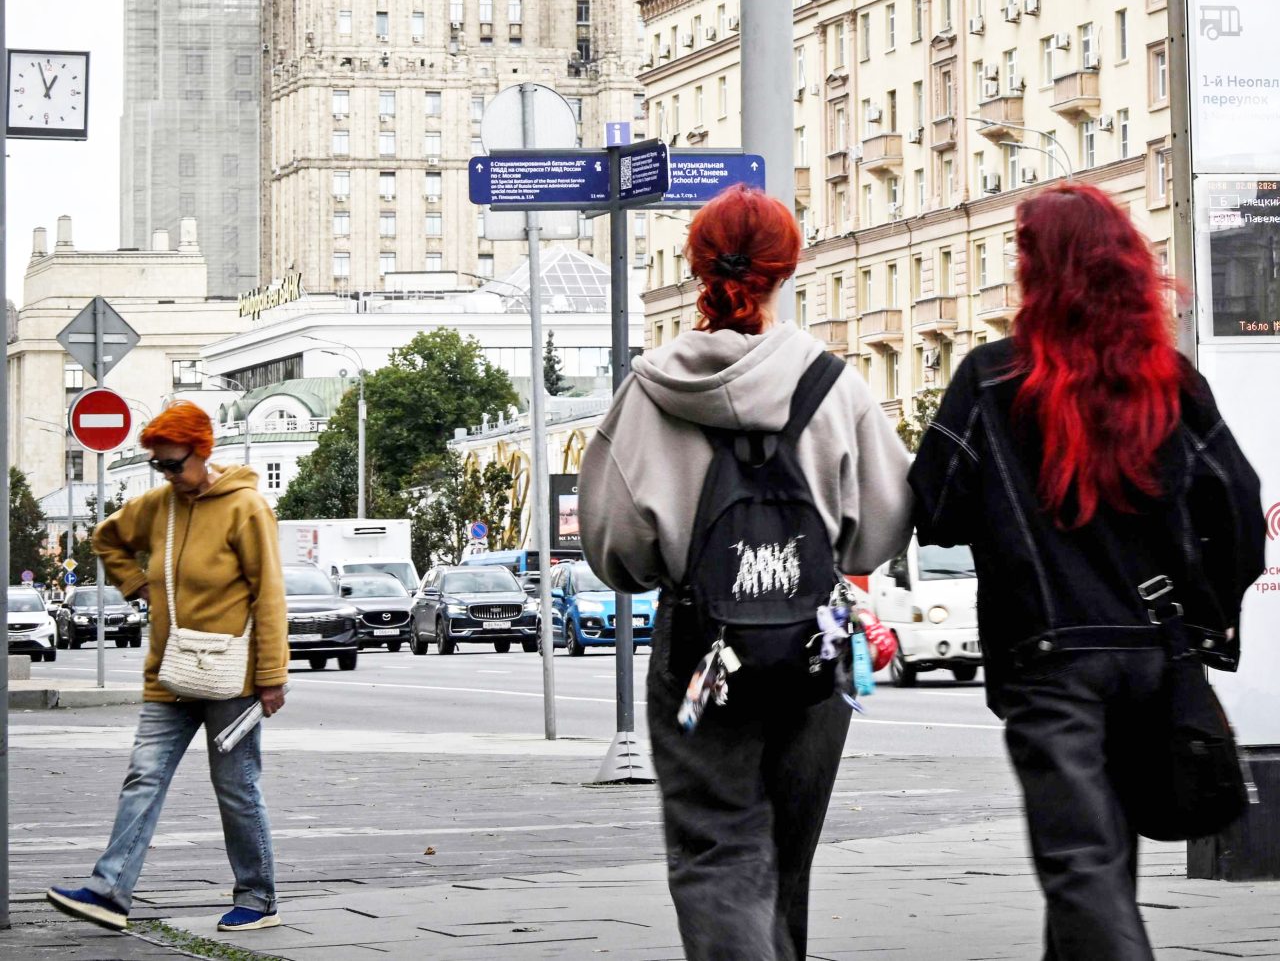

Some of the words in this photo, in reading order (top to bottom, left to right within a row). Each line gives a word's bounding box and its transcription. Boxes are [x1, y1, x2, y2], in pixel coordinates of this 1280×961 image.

[1202, 75, 1223, 88] 1-й
[1202, 94, 1269, 107] переулок
[1239, 321, 1269, 331] Табло
